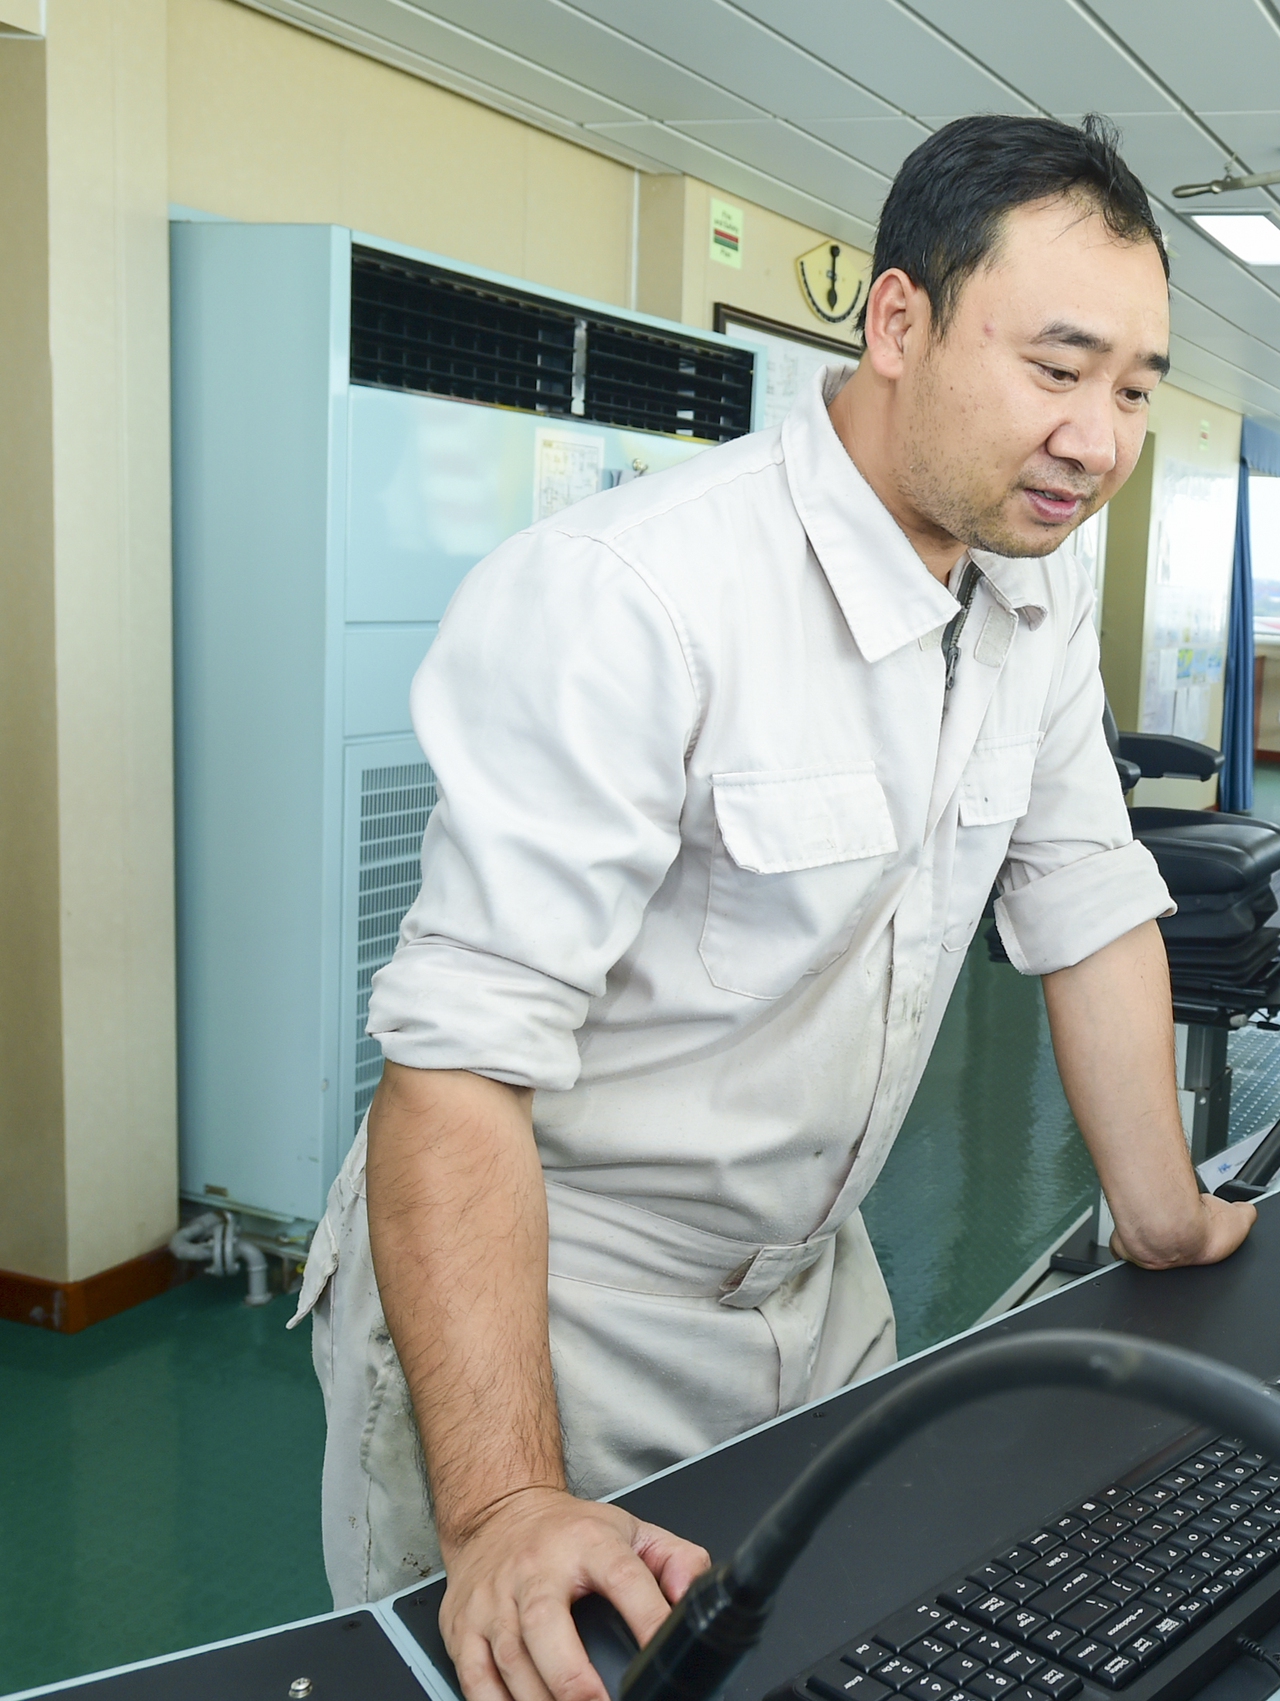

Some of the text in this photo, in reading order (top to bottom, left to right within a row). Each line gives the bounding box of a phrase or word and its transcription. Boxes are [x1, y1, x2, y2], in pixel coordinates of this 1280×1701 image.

[1174, 1476, 1186, 1485] N
[1214, 1481, 1226, 1489] H
[1154, 1490, 1167, 1499] M
[1229, 1503, 1241, 1511] U
[1173, 1509, 1185, 1517] K
[1030, 1533, 1049, 1545] Insert
[1046, 1556, 1062, 1568] Shift
[1232, 1567, 1245, 1576] F10
[1071, 1572, 1089, 1585] Enter
[1211, 1584, 1224, 1593] F11
[978, 1596, 999, 1610] Down
[988, 1599, 1006, 1612] Page
[1187, 1601, 1200, 1611] F12
[1016, 1612, 1029, 1621] Up
[1018, 1615, 1036, 1628] Page
[1107, 1613, 1138, 1637] Backspace
[1046, 1629, 1062, 1641] End
[931, 1644, 943, 1653] 2
[990, 1641, 1000, 1649] 4
[1077, 1643, 1098, 1658] Home
[1003, 1650, 1022, 1664] Home
[1025, 1656, 1036, 1664] 7
[961, 1659, 973, 1669] 5
[1109, 1658, 1130, 1674] Delete
[901, 1665, 913, 1674] 3
[843, 1675, 864, 1690] Enter
[995, 1677, 1007, 1686] 8
[931, 1683, 942, 1692] 6
